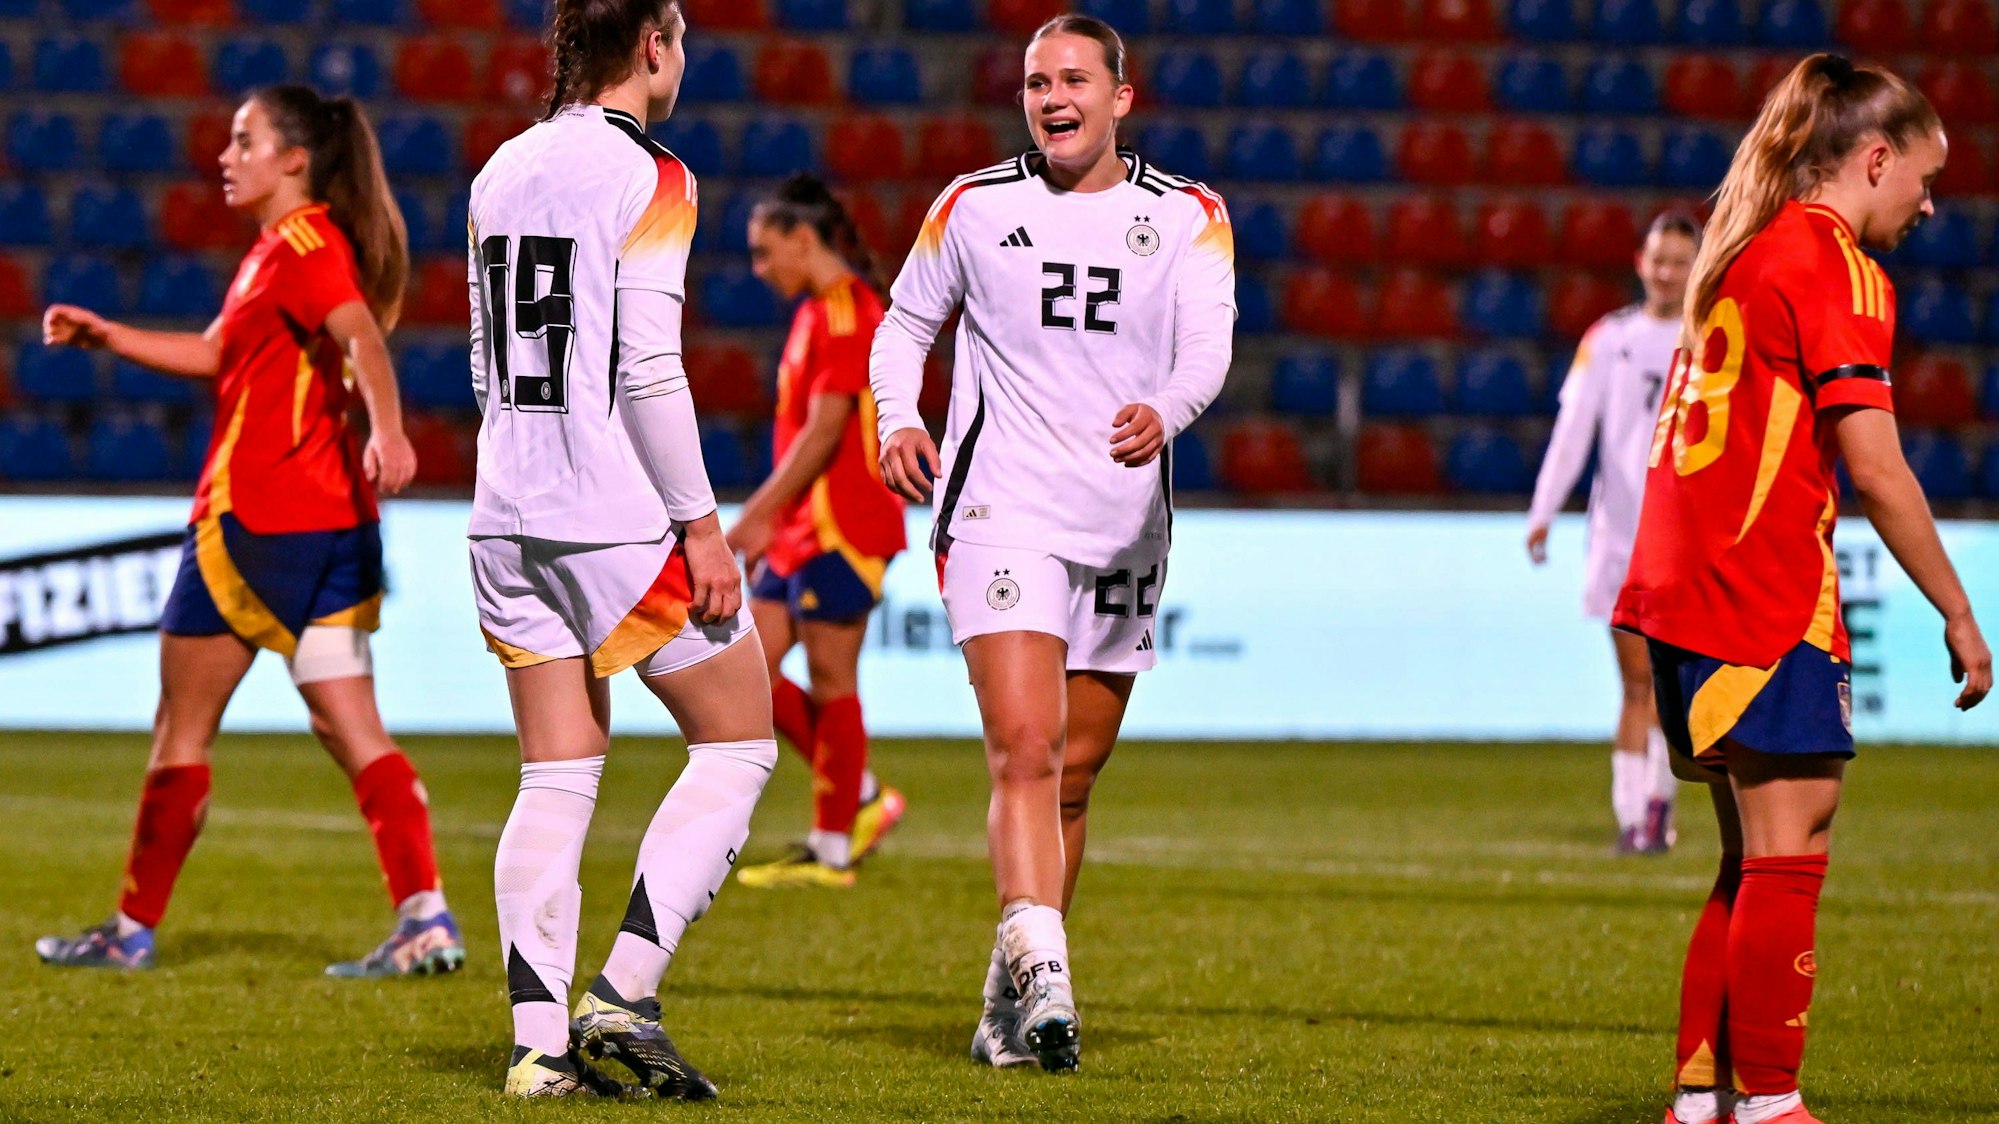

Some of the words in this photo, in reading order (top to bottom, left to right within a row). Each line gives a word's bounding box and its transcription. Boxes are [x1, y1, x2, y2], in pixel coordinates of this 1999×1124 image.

[481, 235, 578, 414] 19
[1041, 262, 1122, 334] 22
[1648, 297, 1746, 477] 18
[1018, 960, 1063, 993] DFB
